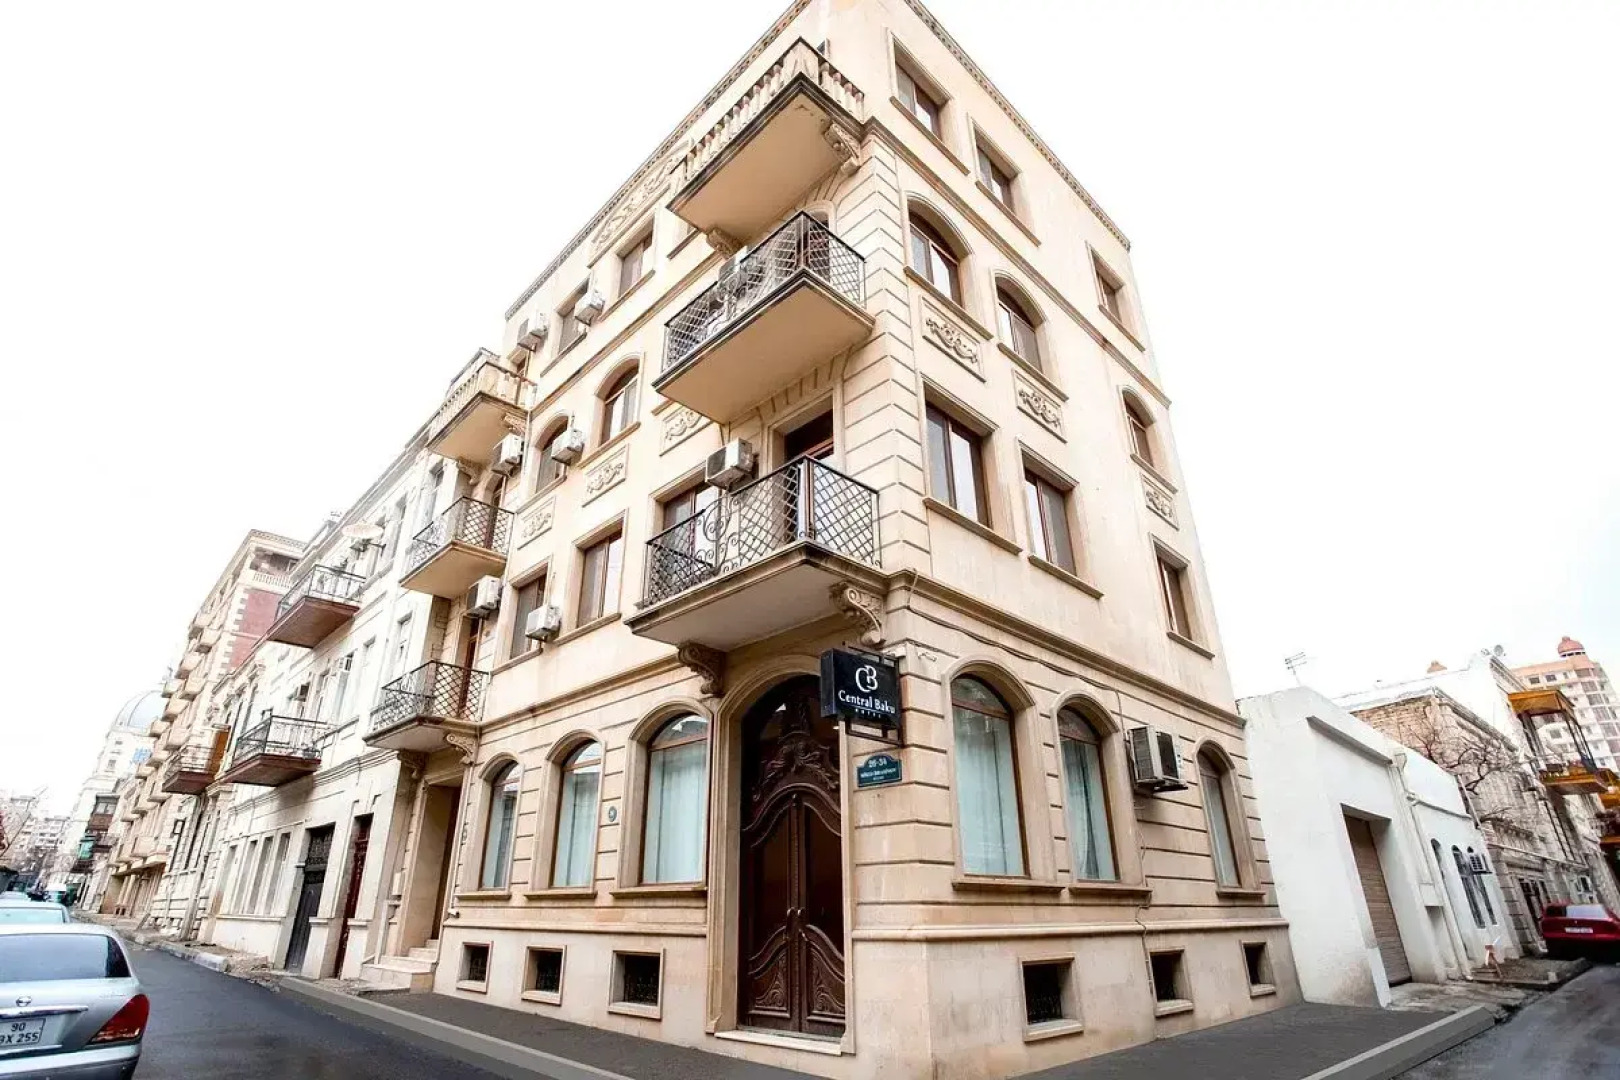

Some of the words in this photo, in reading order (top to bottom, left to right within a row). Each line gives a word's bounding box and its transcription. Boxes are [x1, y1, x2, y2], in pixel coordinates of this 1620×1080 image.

[838, 690, 873, 708] Central
[874, 699, 896, 714] Baku
[11, 1022, 27, 1032] 90
[16, 1032, 39, 1043] 255
